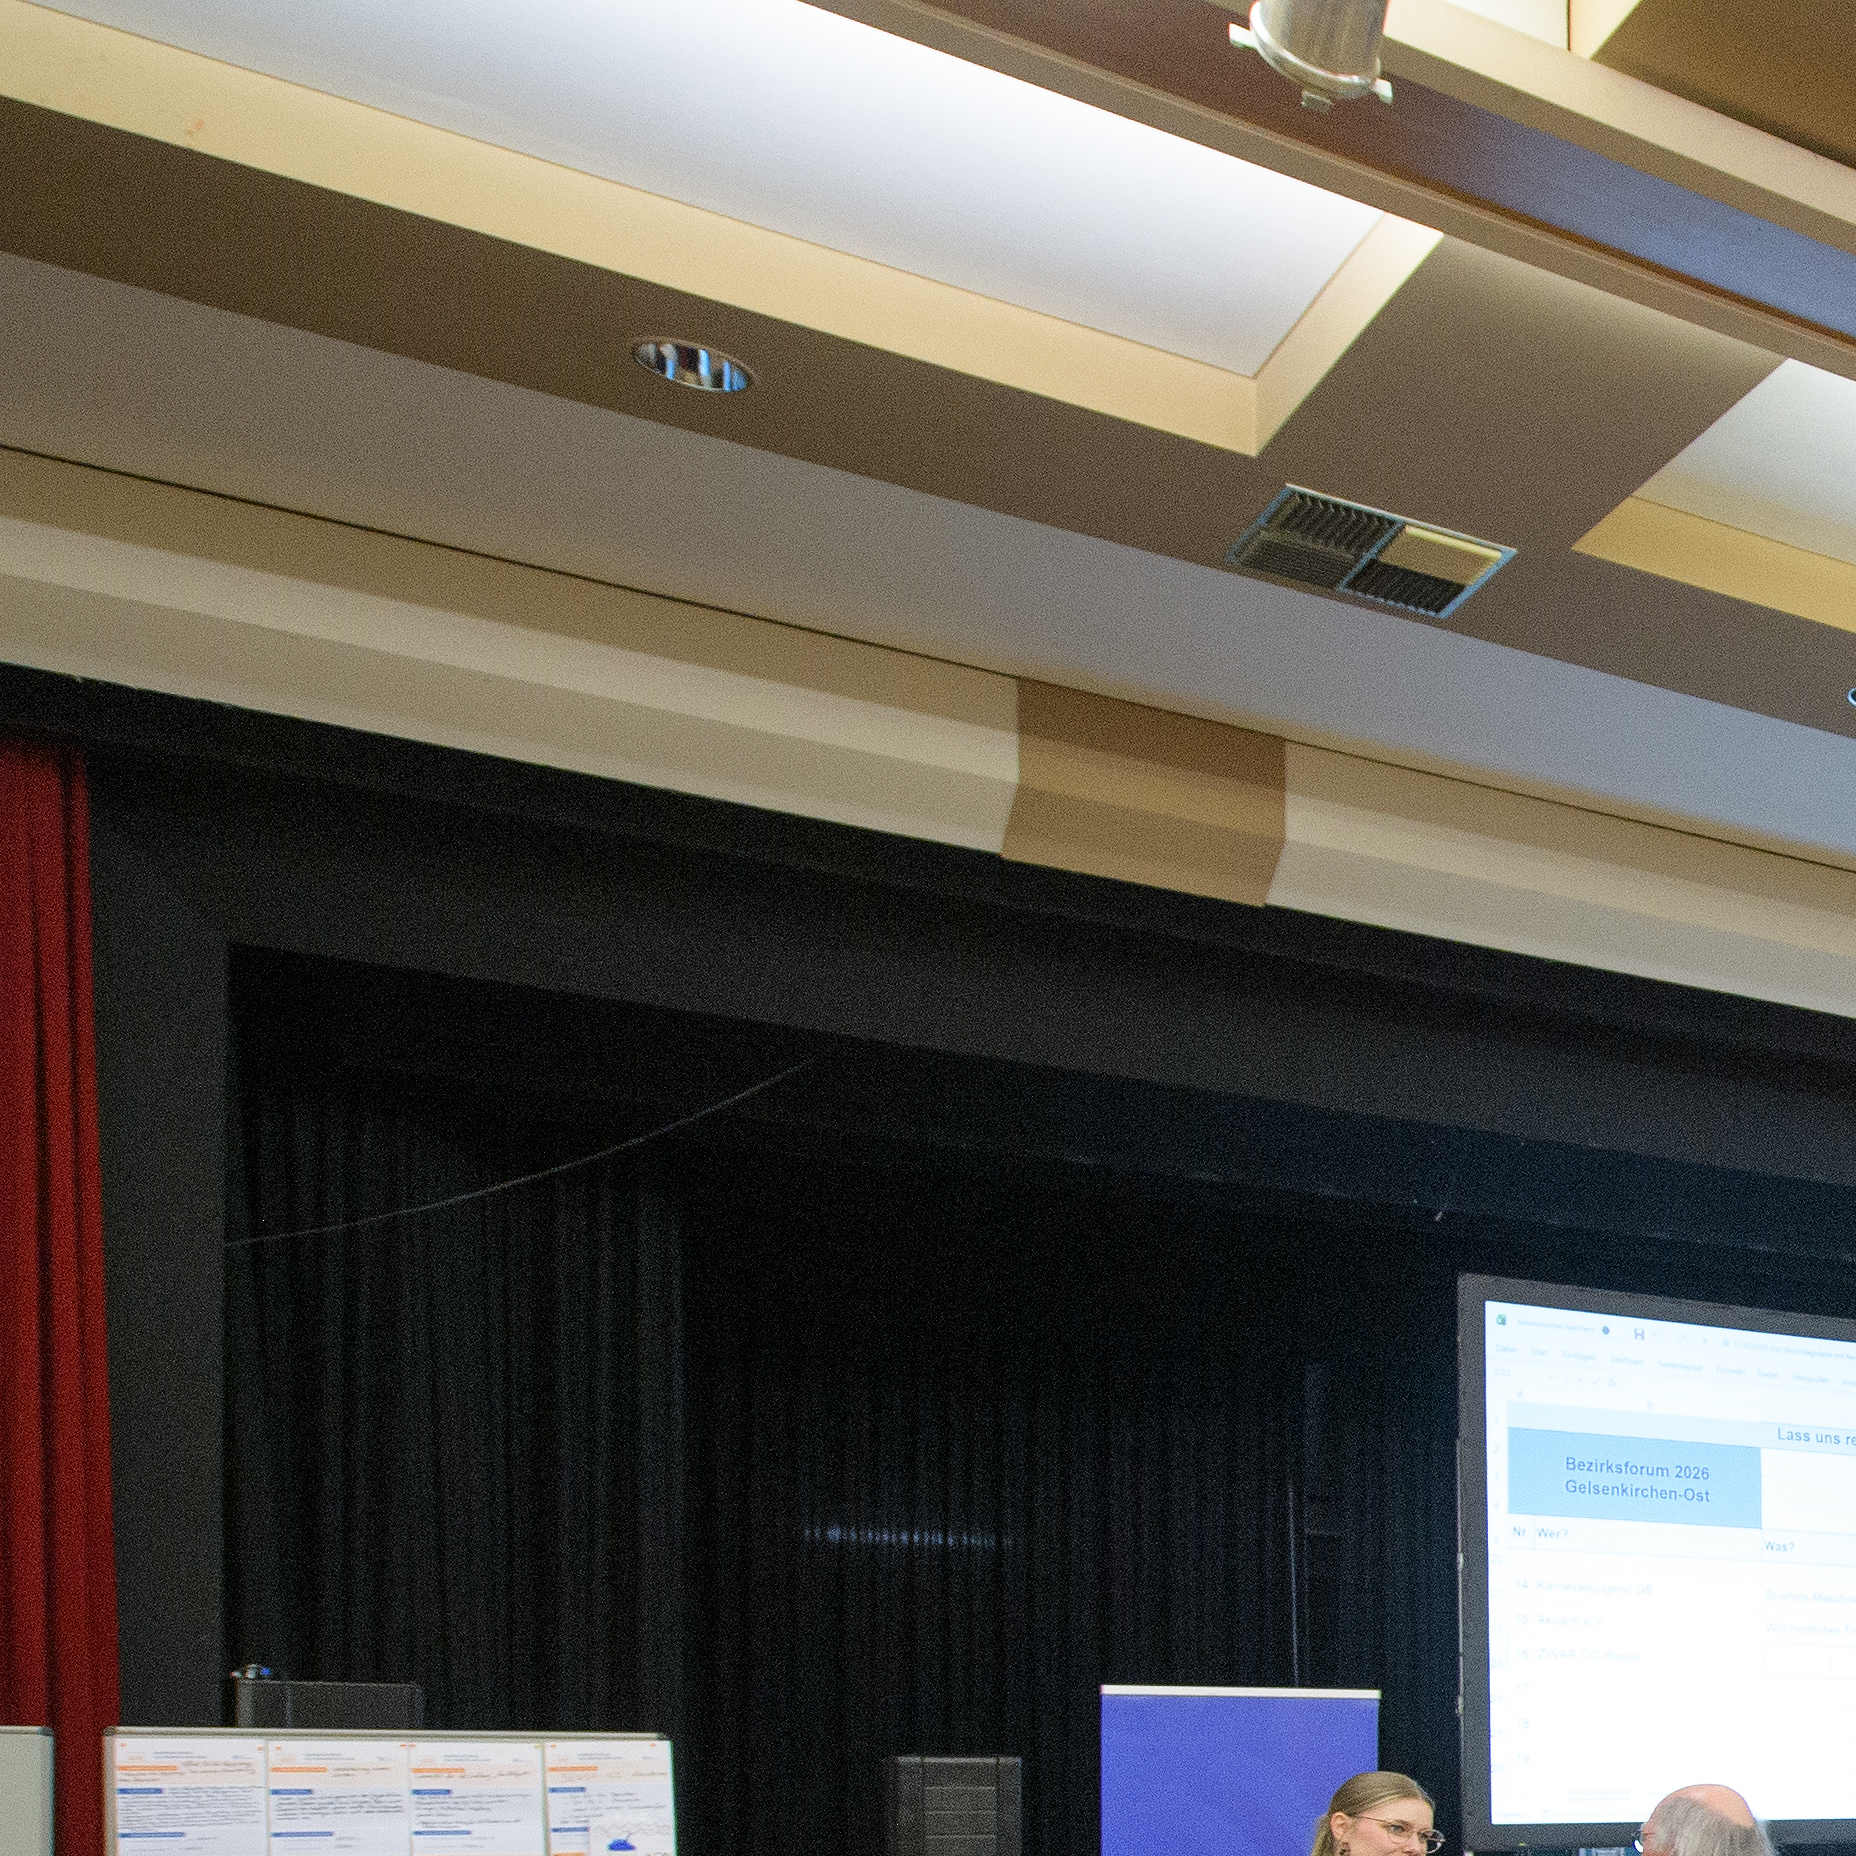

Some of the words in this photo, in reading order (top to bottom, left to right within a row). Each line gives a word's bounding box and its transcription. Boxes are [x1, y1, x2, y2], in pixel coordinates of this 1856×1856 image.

[1777, 1426, 1811, 1442] Lass
[1815, 1432, 1841, 1445] uns
[1565, 1456, 1670, 1478] Bezirksforum
[1674, 1464, 1710, 1481] 2026
[1564, 1480, 1711, 1503] Gelsenkirchen-Ost
[1764, 1541, 1795, 1552] Was?
